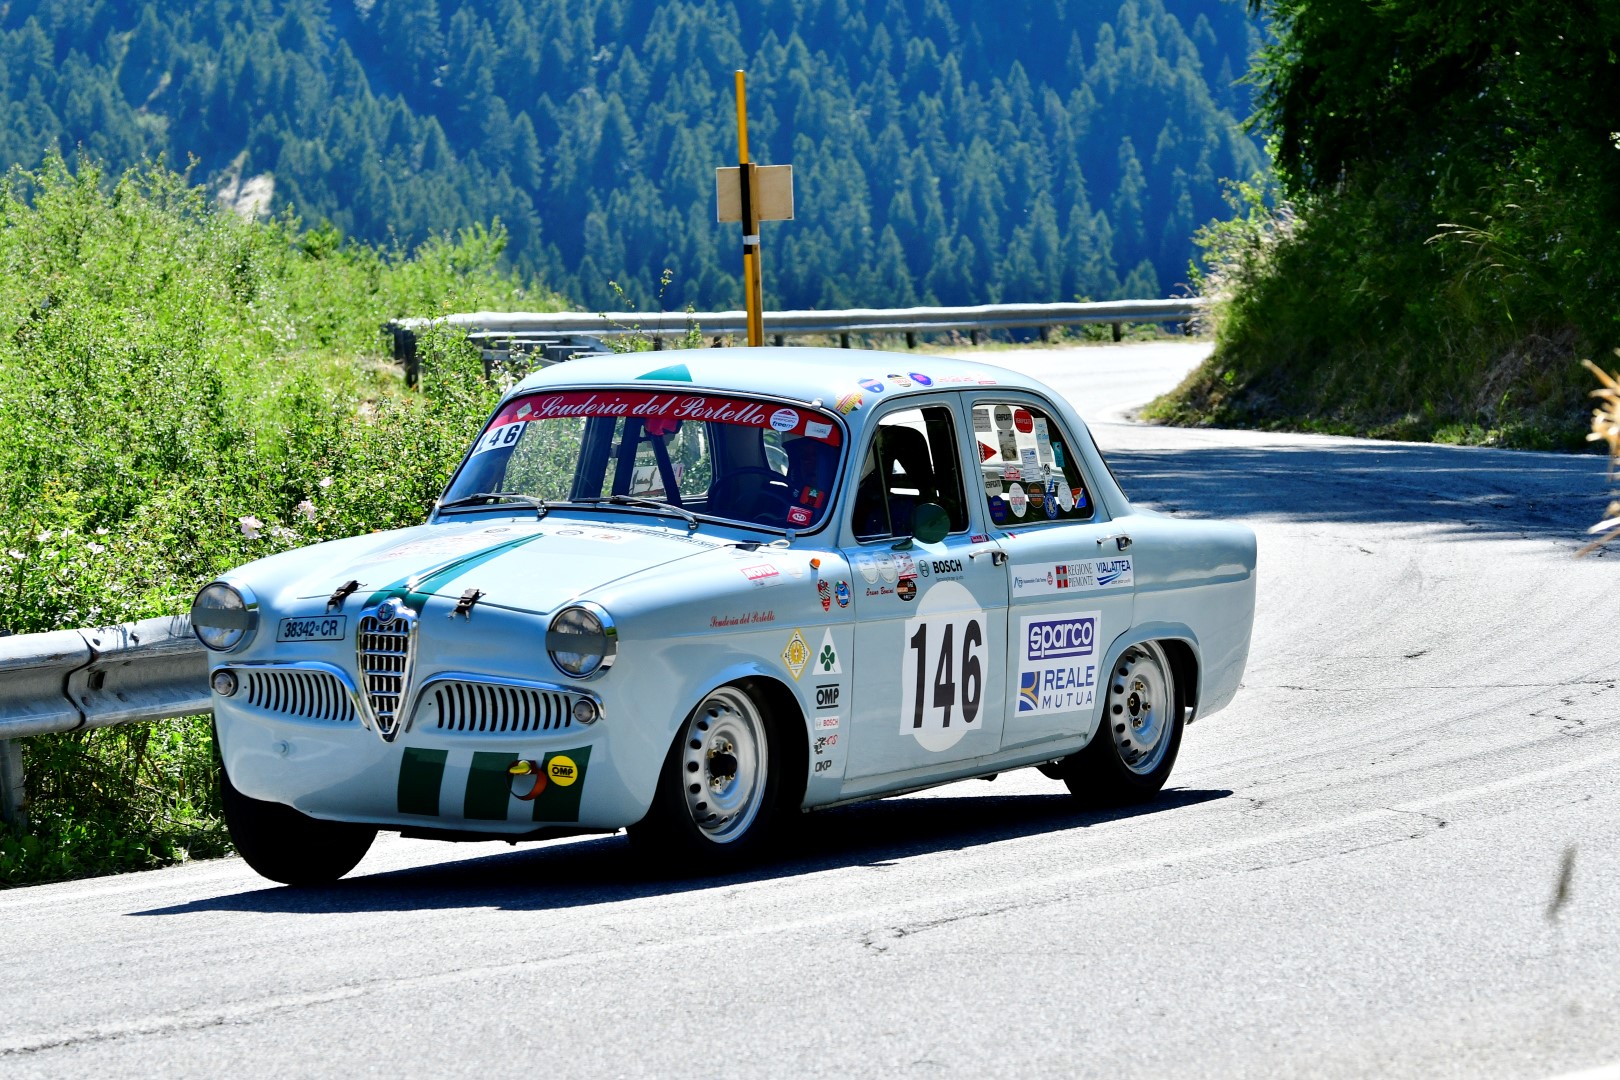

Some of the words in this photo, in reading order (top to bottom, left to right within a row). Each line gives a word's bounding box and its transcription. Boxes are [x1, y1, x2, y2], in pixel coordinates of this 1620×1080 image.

[533, 395, 629, 418] Scuderia
[632, 395, 678, 415] del
[673, 396, 767, 424] Portello
[474, 424, 520, 453] 146
[744, 565, 778, 578] MOTUL
[932, 559, 963, 574] BOSCH
[1067, 562, 1093, 576] REGIONE
[1096, 560, 1131, 574] VIALATTEA
[1068, 575, 1094, 588] PIEMONTE
[1030, 621, 1093, 658] sparco
[911, 619, 982, 729] 146
[1043, 665, 1096, 691] REALE
[816, 687, 840, 705] OMP
[1042, 690, 1093, 710] MUTUA
[823, 718, 839, 727] BOSCH
[551, 766, 574, 776] OMP
